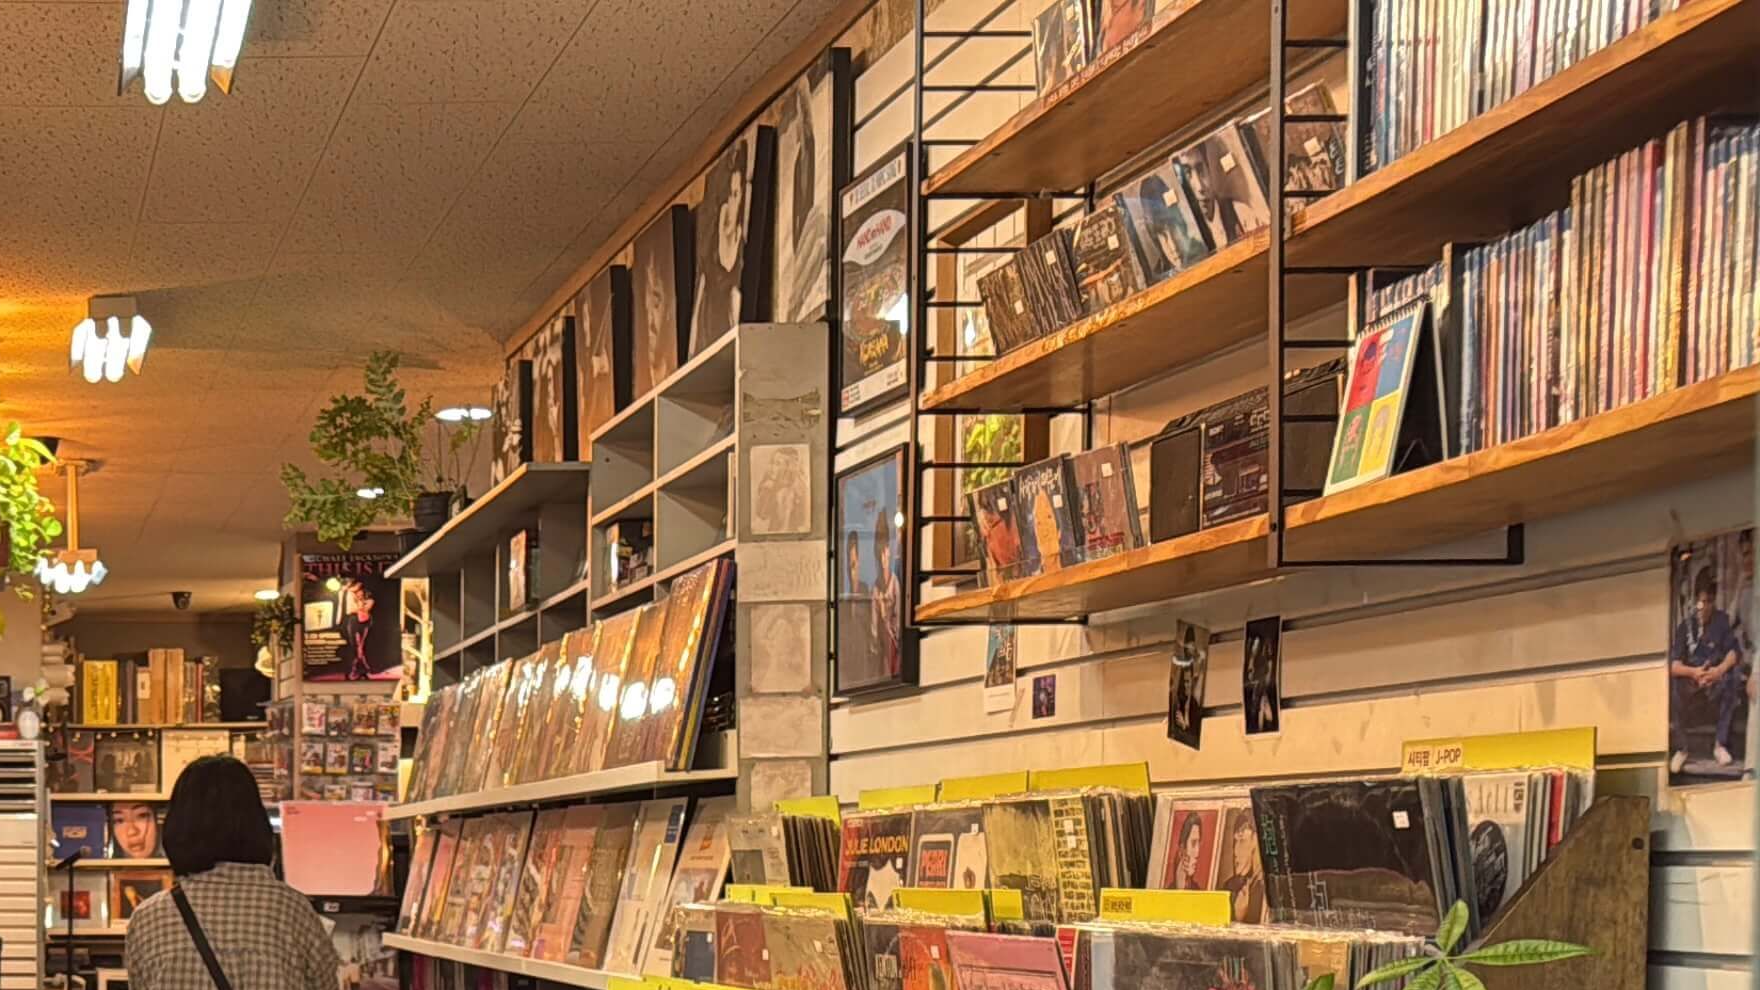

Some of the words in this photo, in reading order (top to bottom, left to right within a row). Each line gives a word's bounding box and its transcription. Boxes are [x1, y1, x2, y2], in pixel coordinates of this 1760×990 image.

[357, 562, 373, 575] IS
[1435, 747, 1461, 764] J-POP
[870, 835, 909, 854] LONDON
